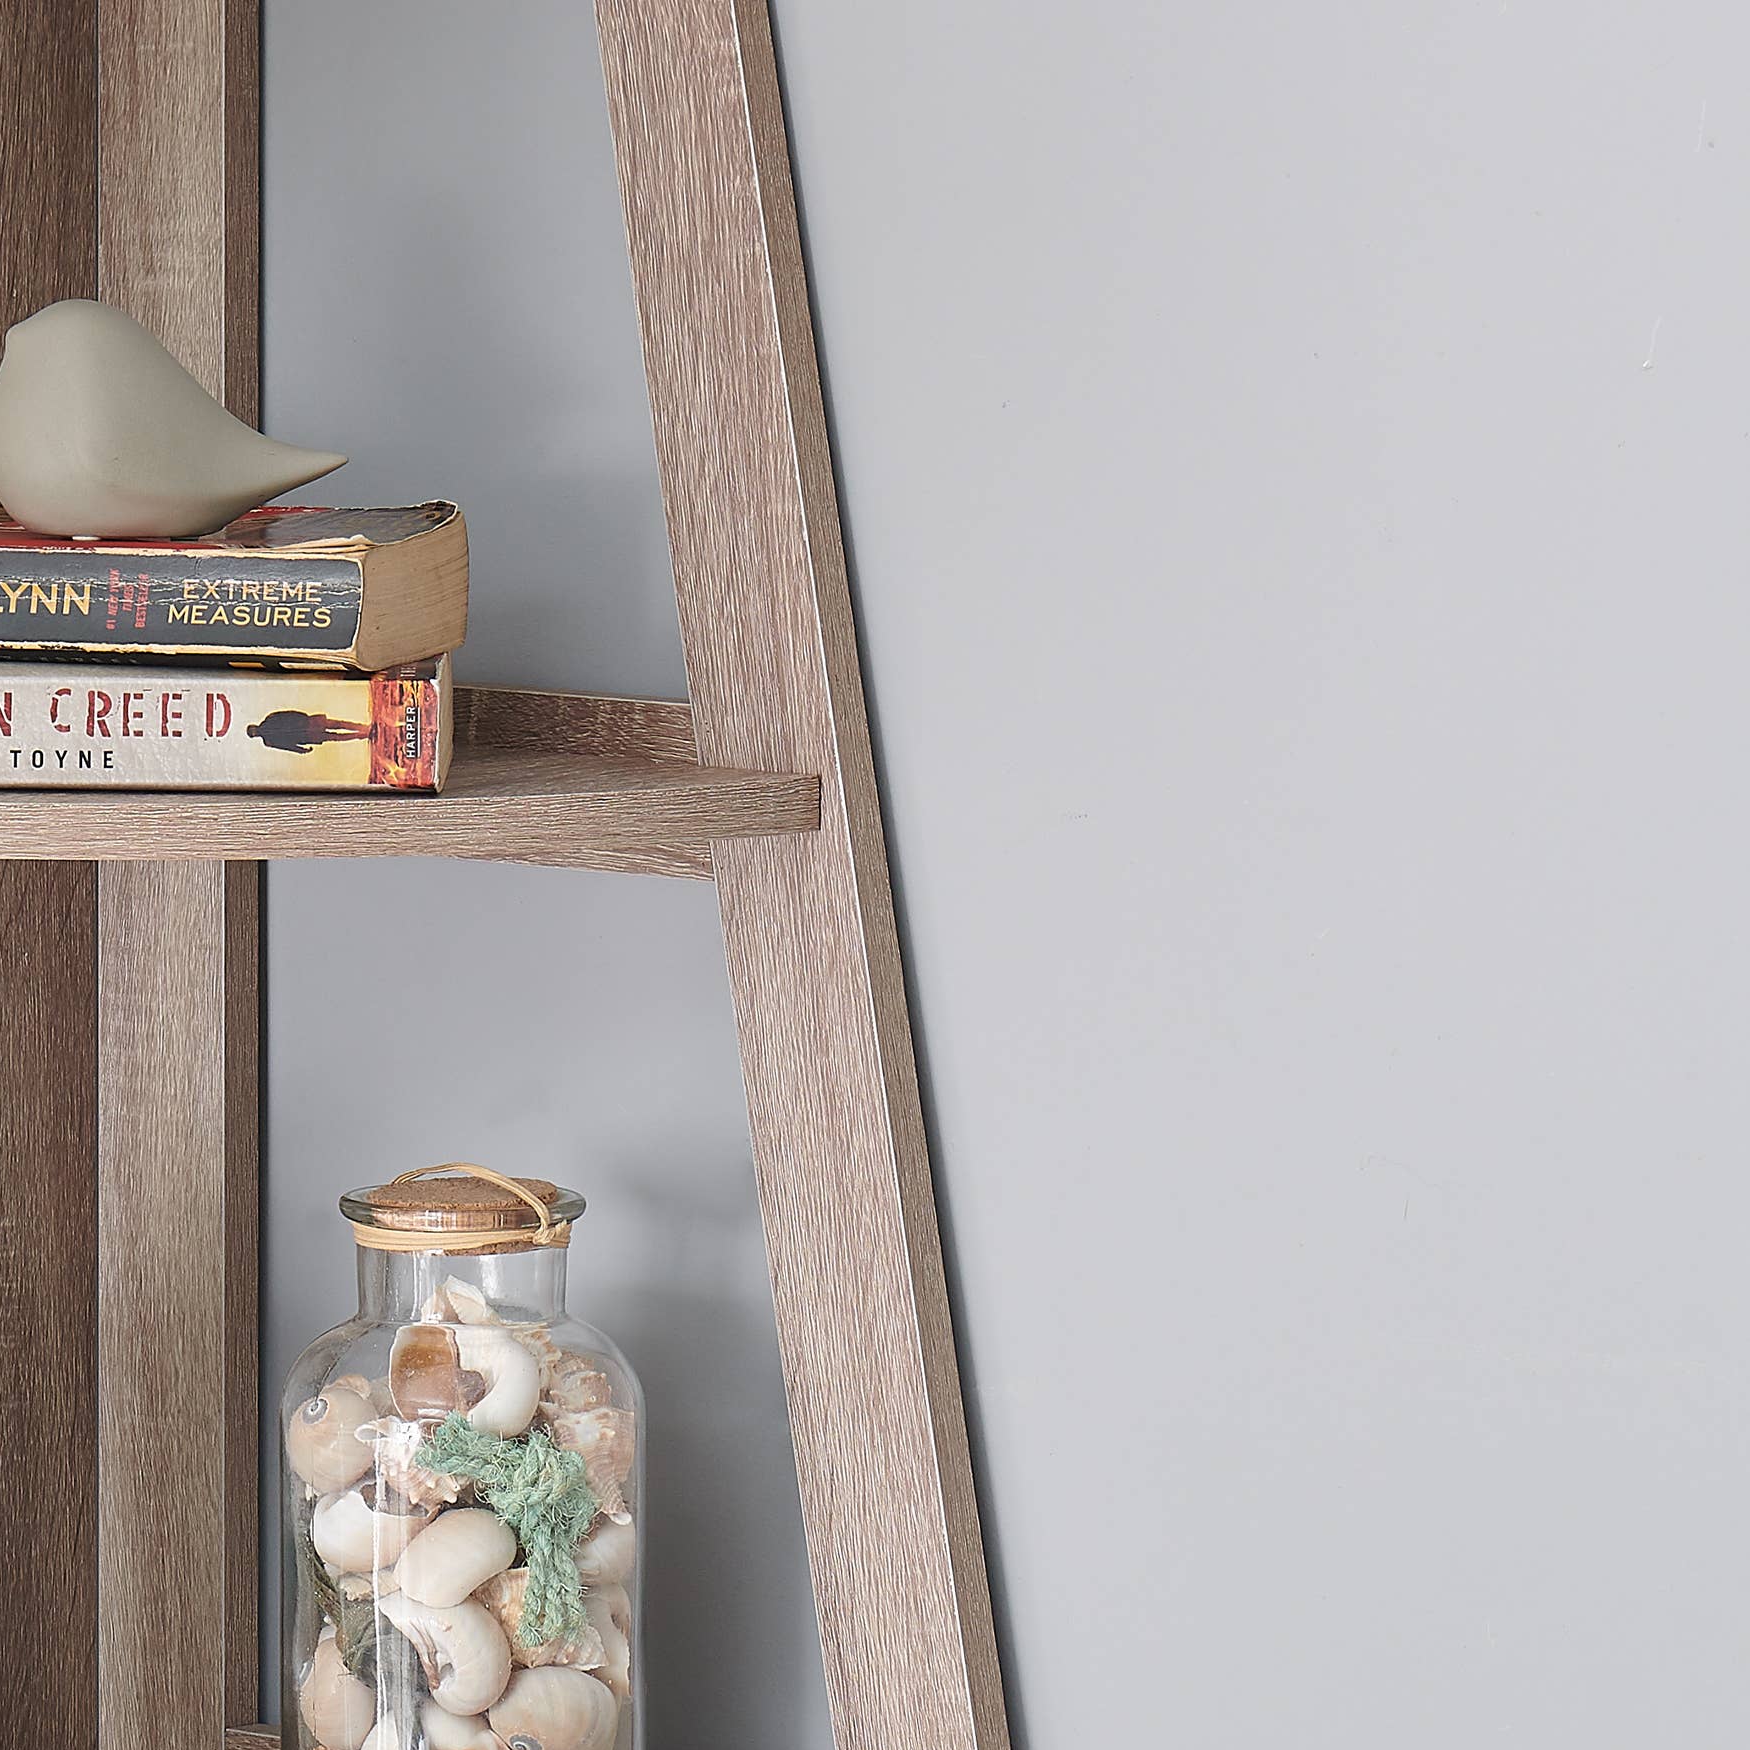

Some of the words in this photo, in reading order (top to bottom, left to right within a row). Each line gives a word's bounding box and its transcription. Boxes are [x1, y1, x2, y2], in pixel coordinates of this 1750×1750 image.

[182, 578, 323, 603] EXTREME
[167, 604, 332, 628] MEASURES
[49, 687, 232, 738] CREED
[405, 706, 416, 758] HARPER
[9, 749, 115, 769] TOYNE
